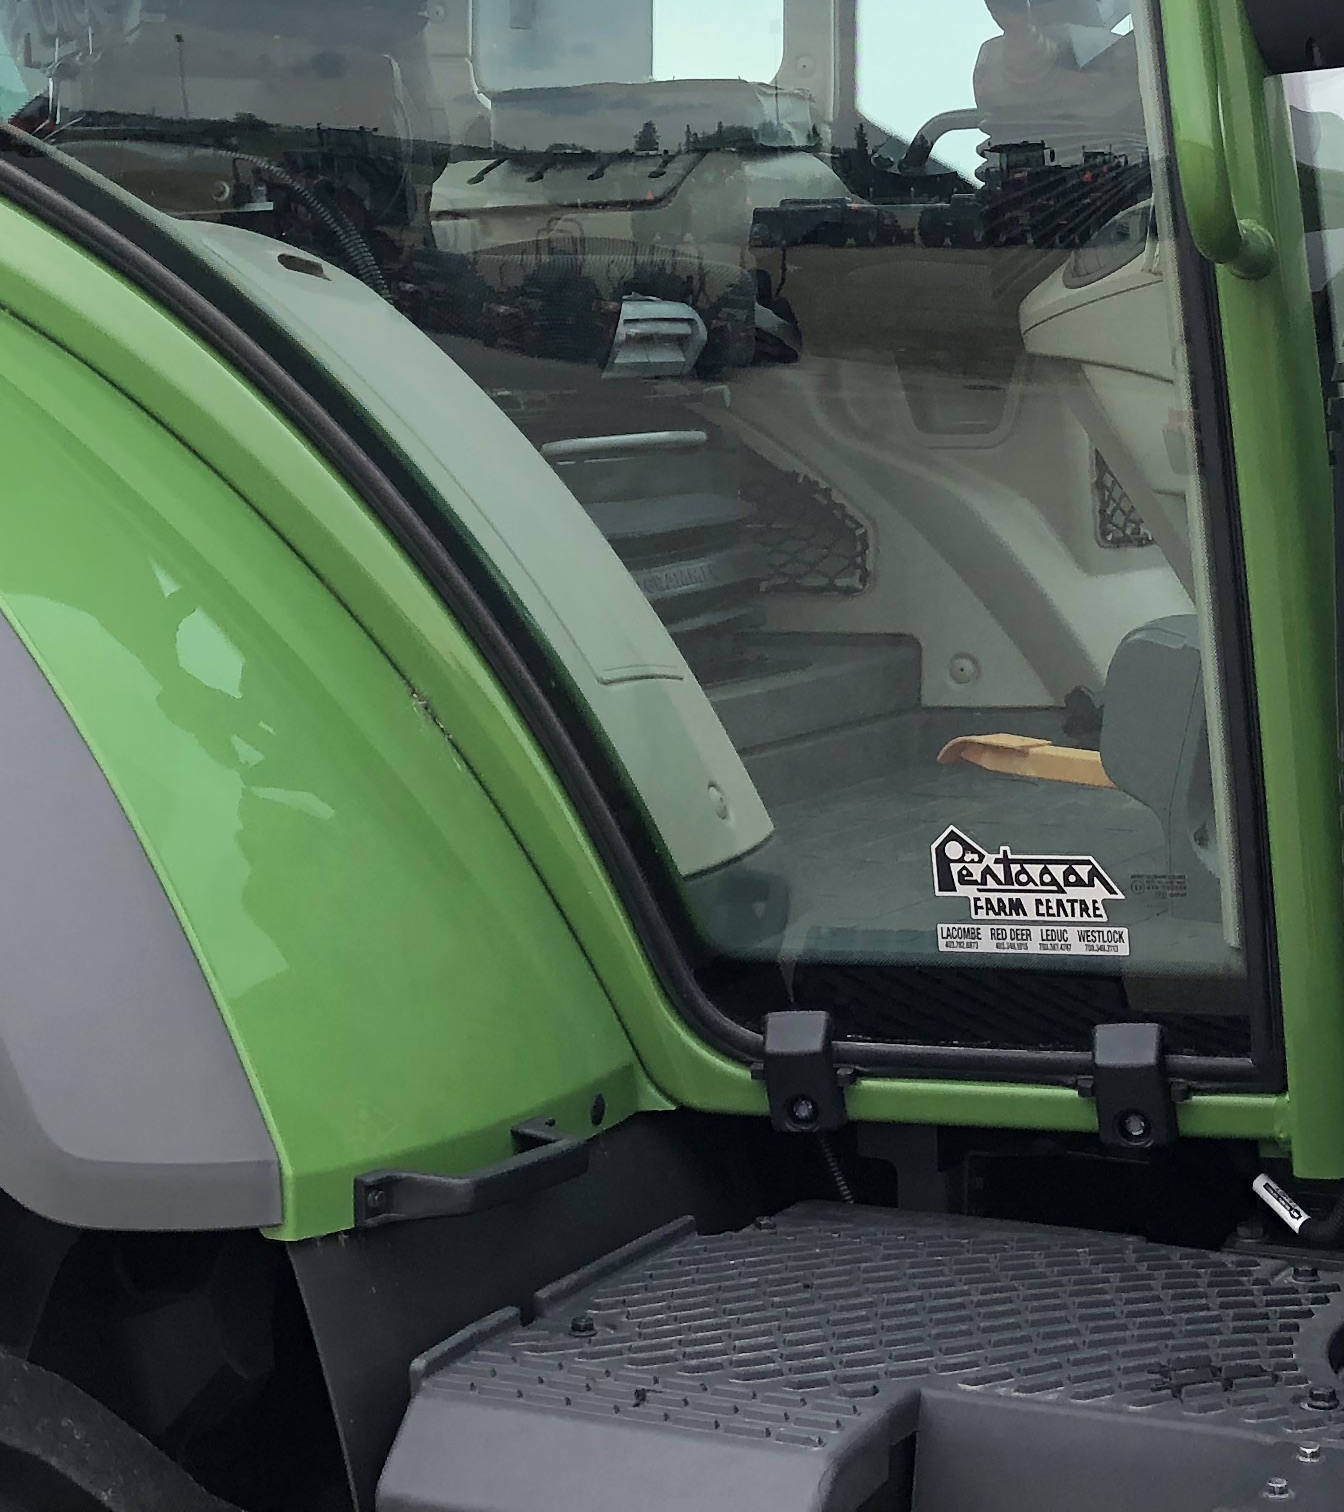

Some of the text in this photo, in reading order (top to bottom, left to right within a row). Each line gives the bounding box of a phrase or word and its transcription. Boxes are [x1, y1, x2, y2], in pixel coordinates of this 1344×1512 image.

[935, 829, 1118, 895] Pentagon
[973, 896, 1104, 919] FARM CENTRE
[940, 926, 1125, 944] LACOMBE RED DEER LEDUC WESTLOCK
